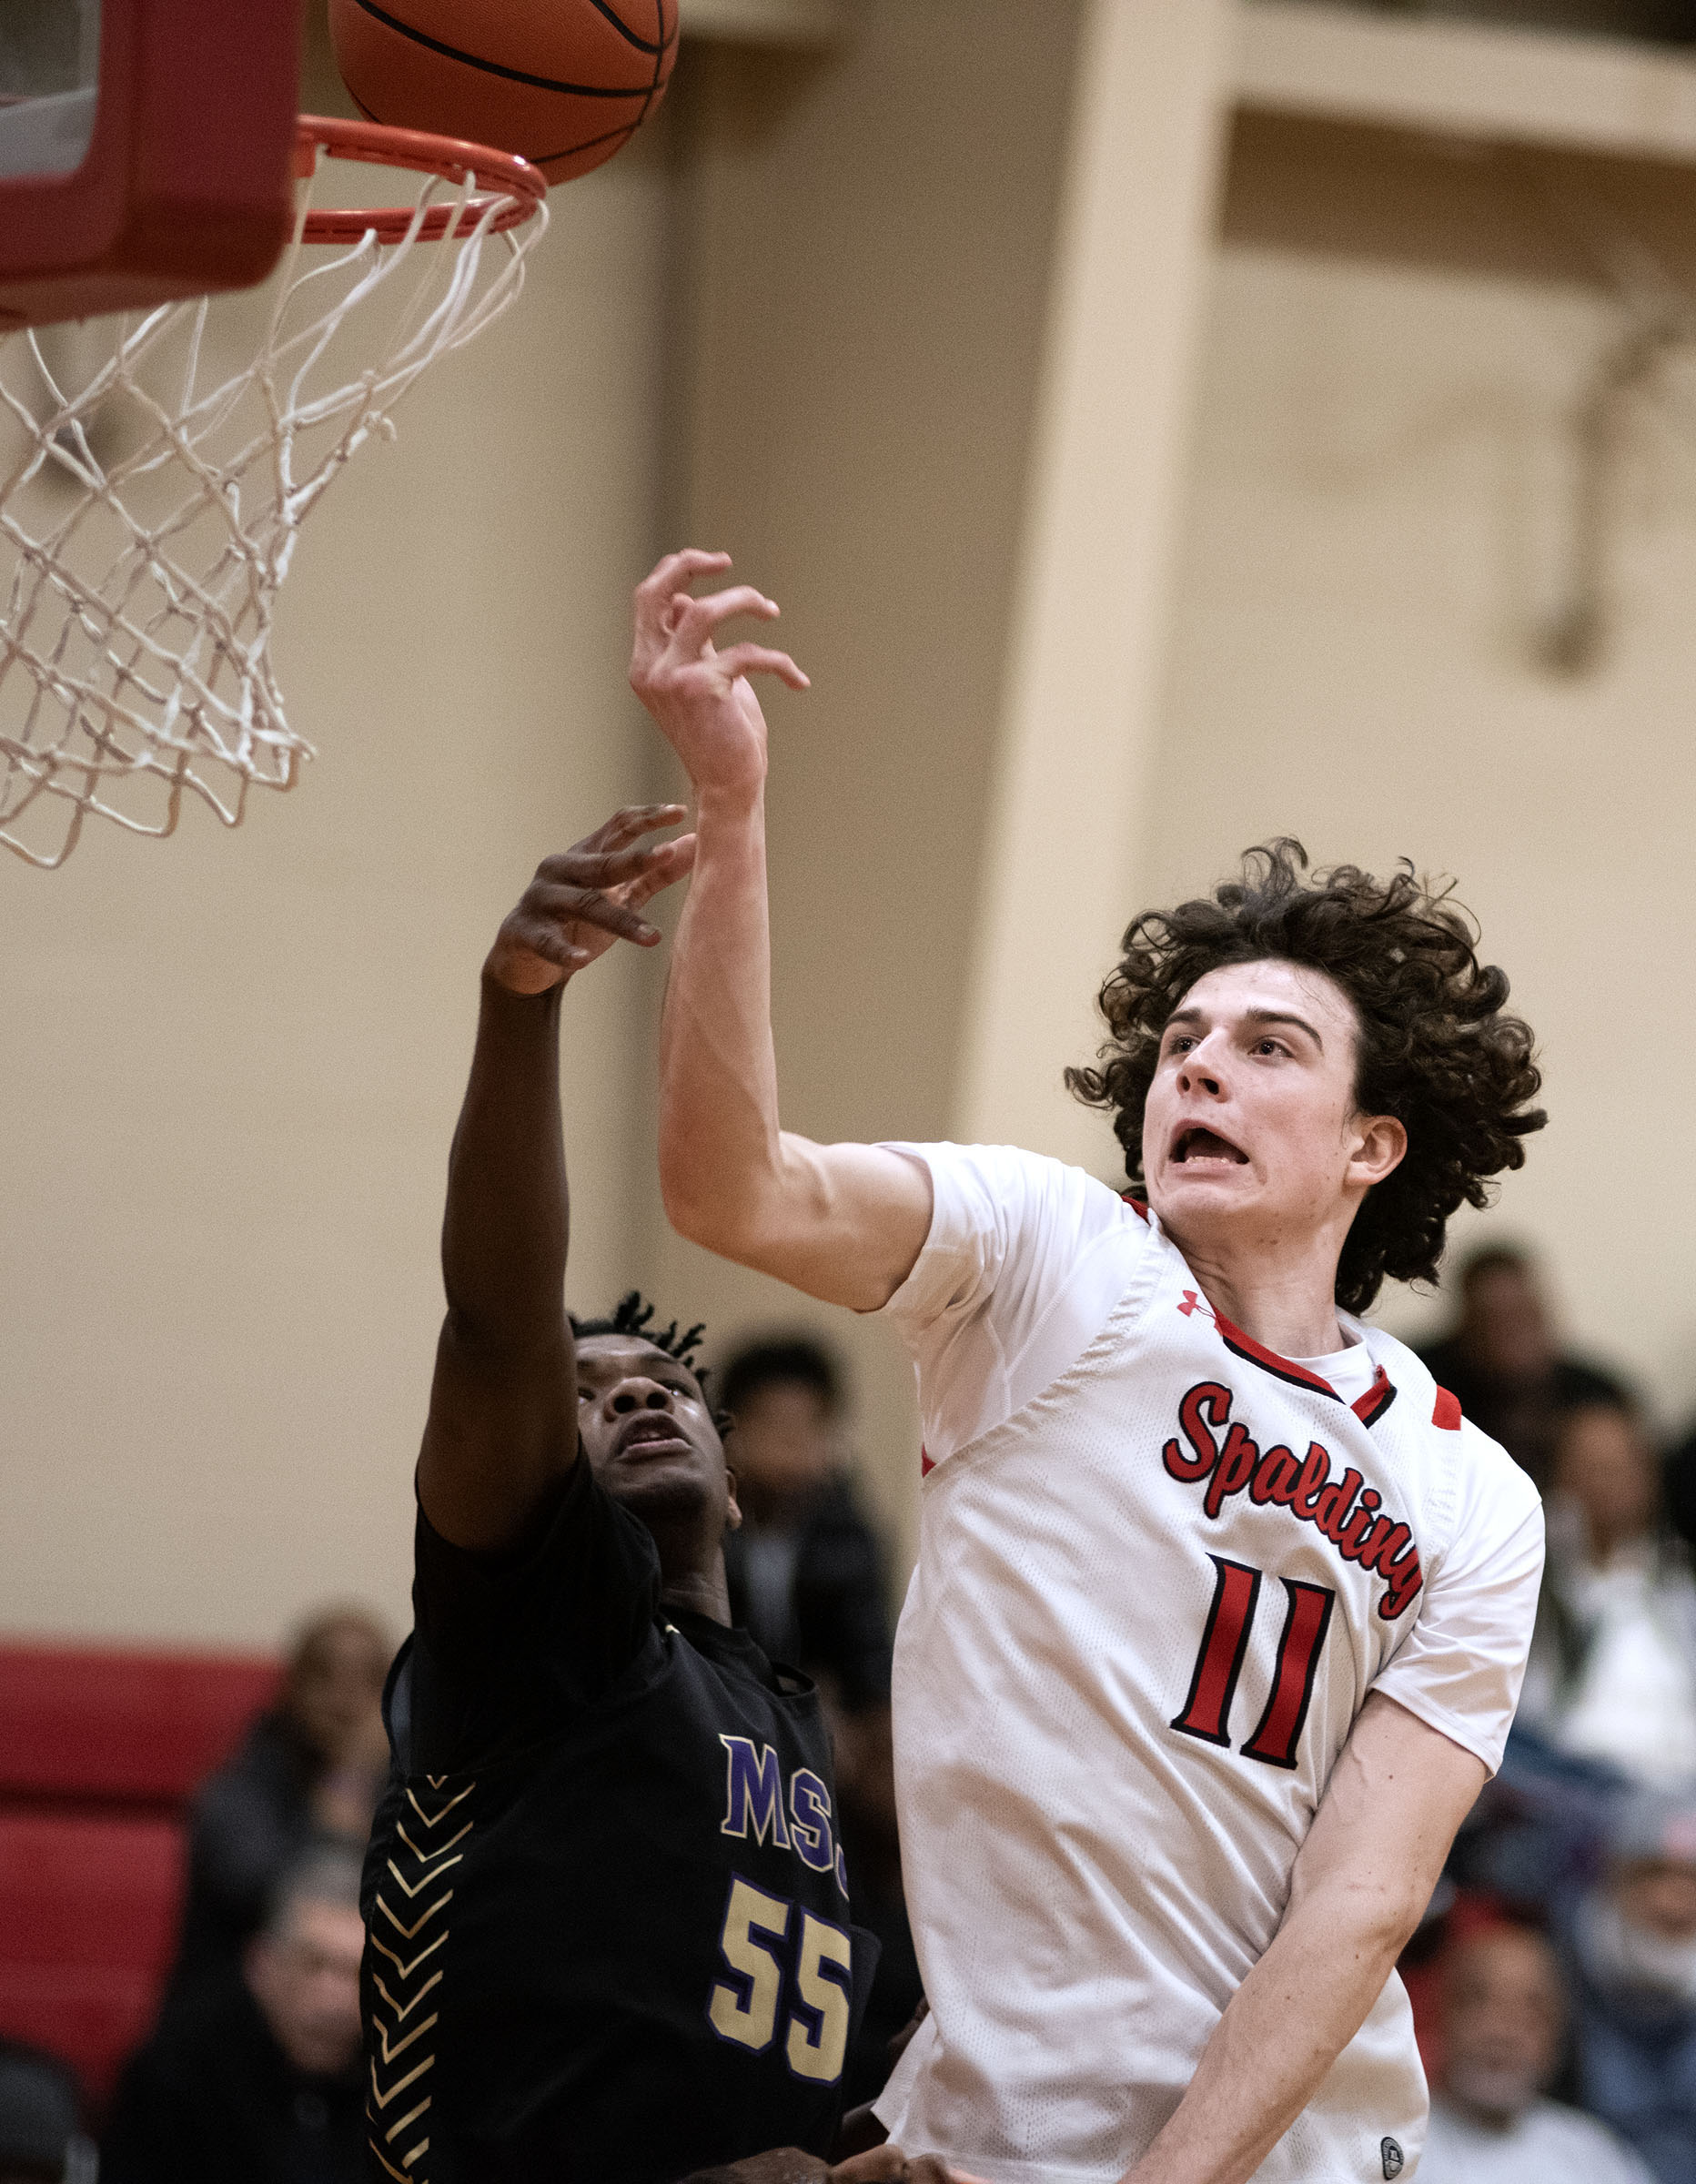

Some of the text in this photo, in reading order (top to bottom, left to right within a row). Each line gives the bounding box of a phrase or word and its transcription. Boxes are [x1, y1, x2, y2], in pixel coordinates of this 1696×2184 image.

[1162, 1381, 1423, 1620] Spalding
[1170, 1552, 1336, 1770] 11
[705, 1871, 853, 2088] 55
